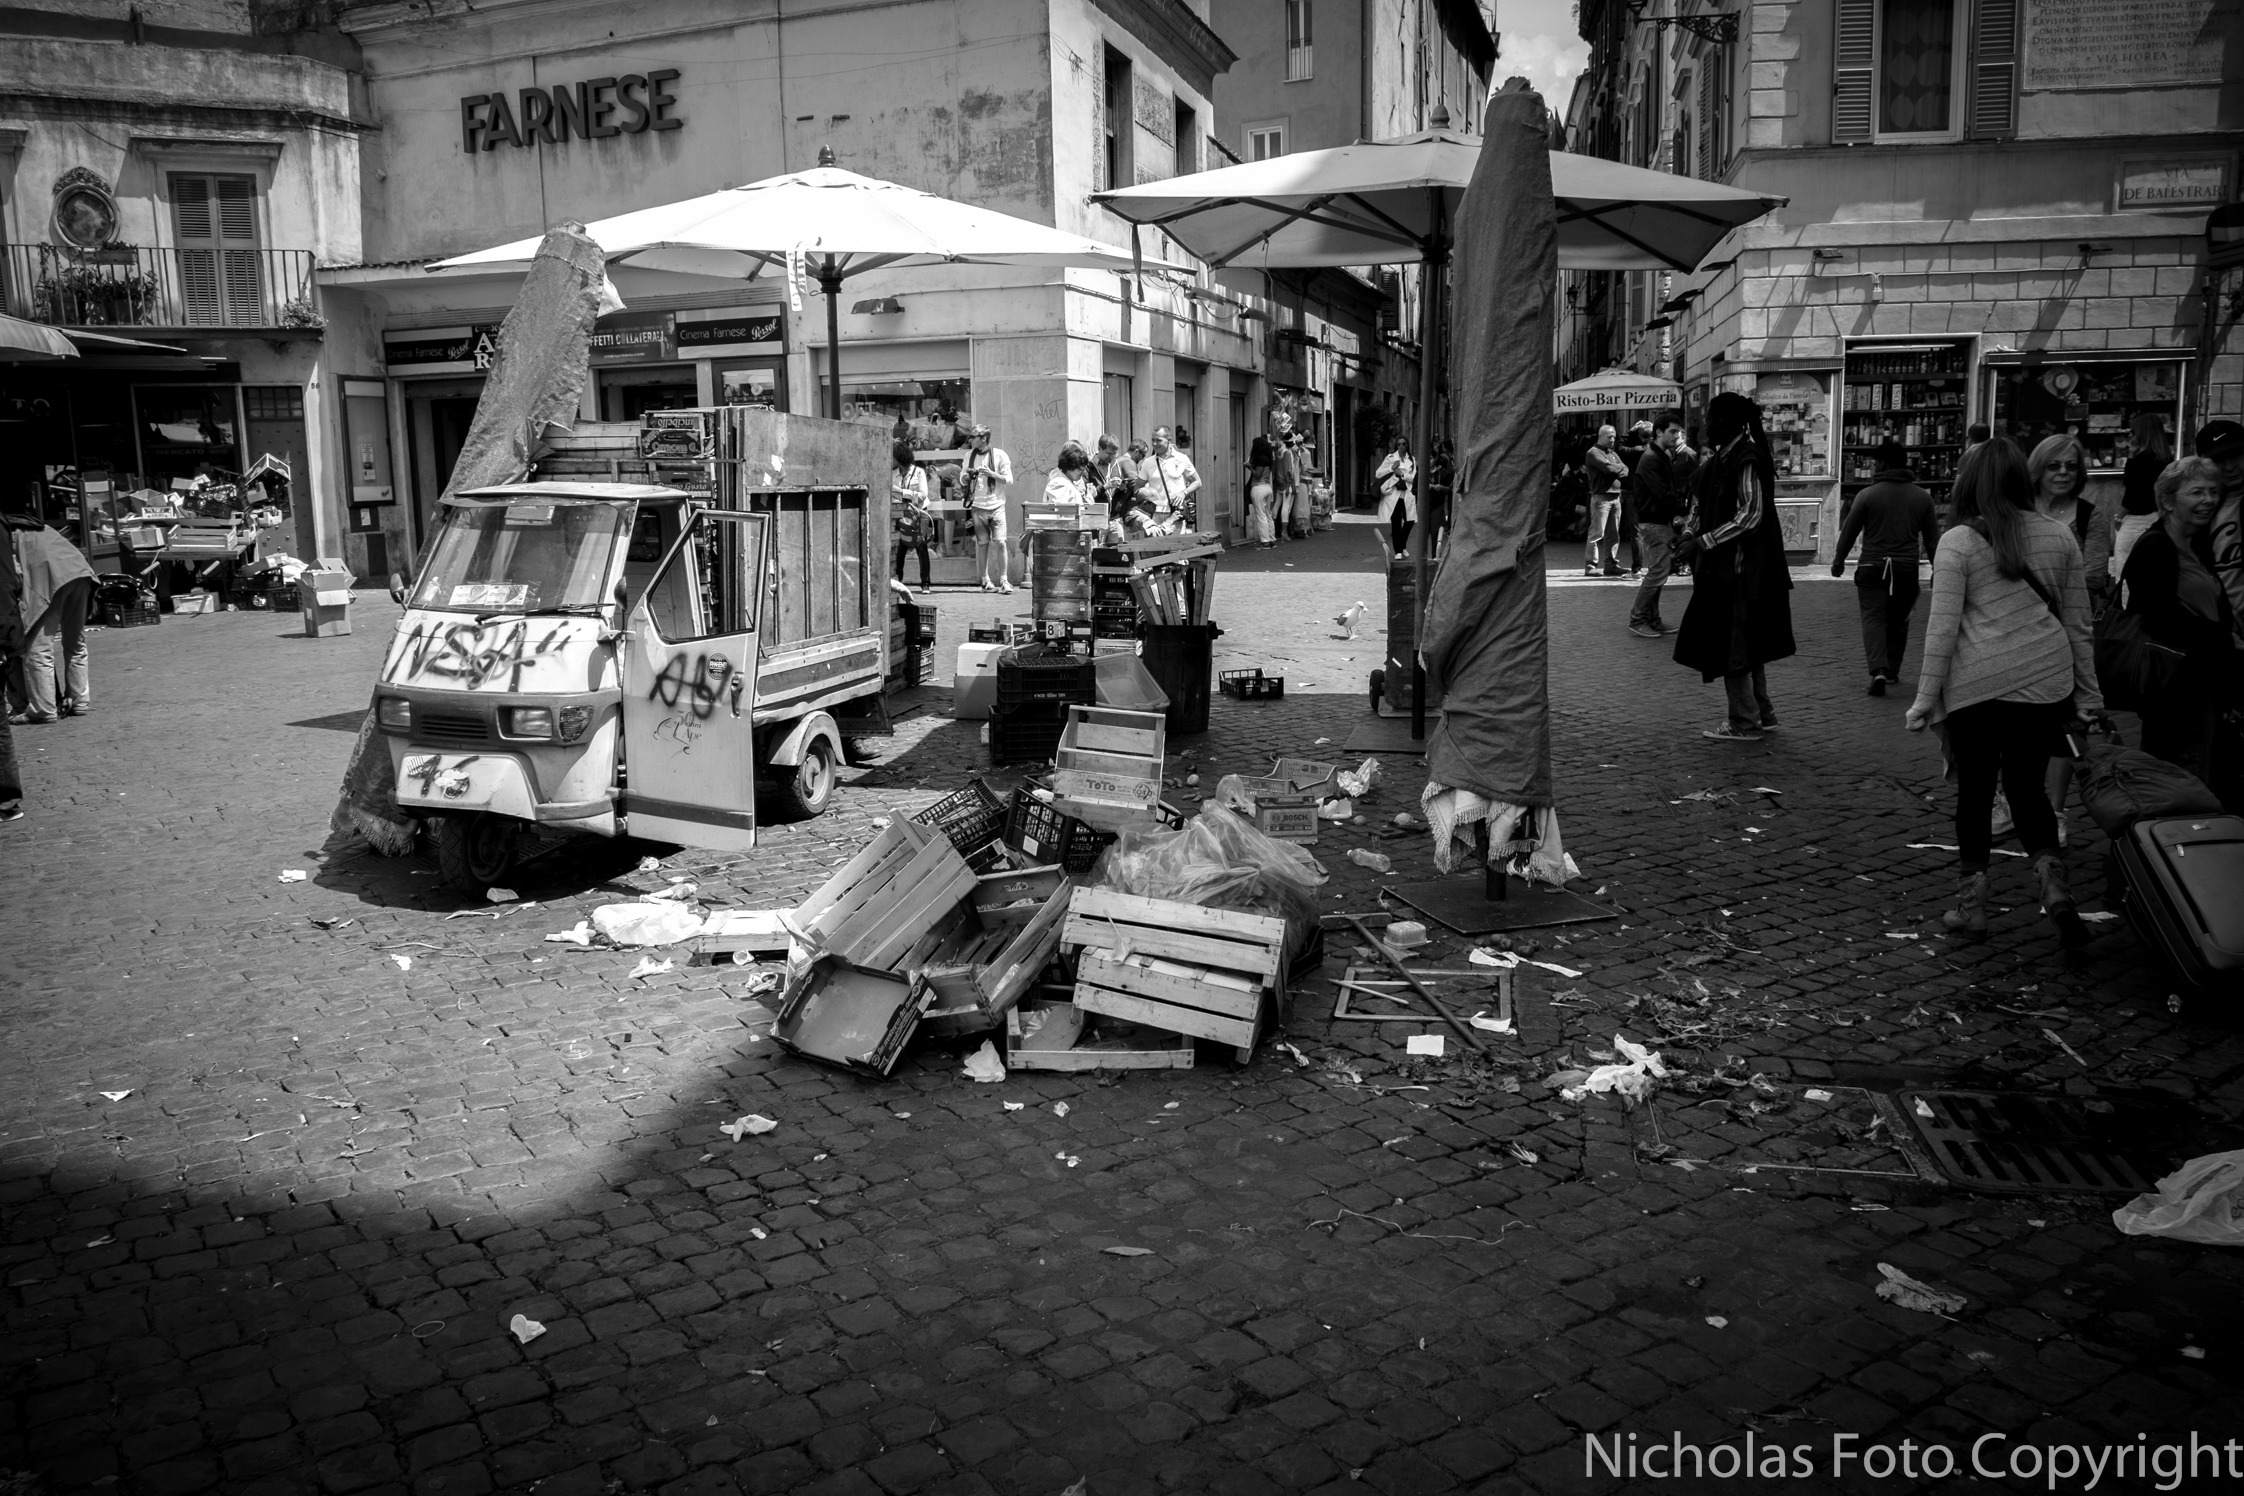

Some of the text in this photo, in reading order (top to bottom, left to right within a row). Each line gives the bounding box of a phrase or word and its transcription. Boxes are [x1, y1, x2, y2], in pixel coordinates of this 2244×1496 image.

[2096, 52, 2167, 62] VIA FLOREA
[461, 68, 684, 153] FARNESE
[2164, 167, 2189, 179] VIA
[2147, 184, 2227, 199] BALESTRARI
[679, 328, 710, 341] Cinema
[713, 325, 746, 338] Farnese
[751, 318, 778, 341] Persol
[387, 348, 413, 359] Cinema
[414, 347, 444, 357] Farnese
[1557, 390, 1677, 408] Risto-Bar Pizzeria
